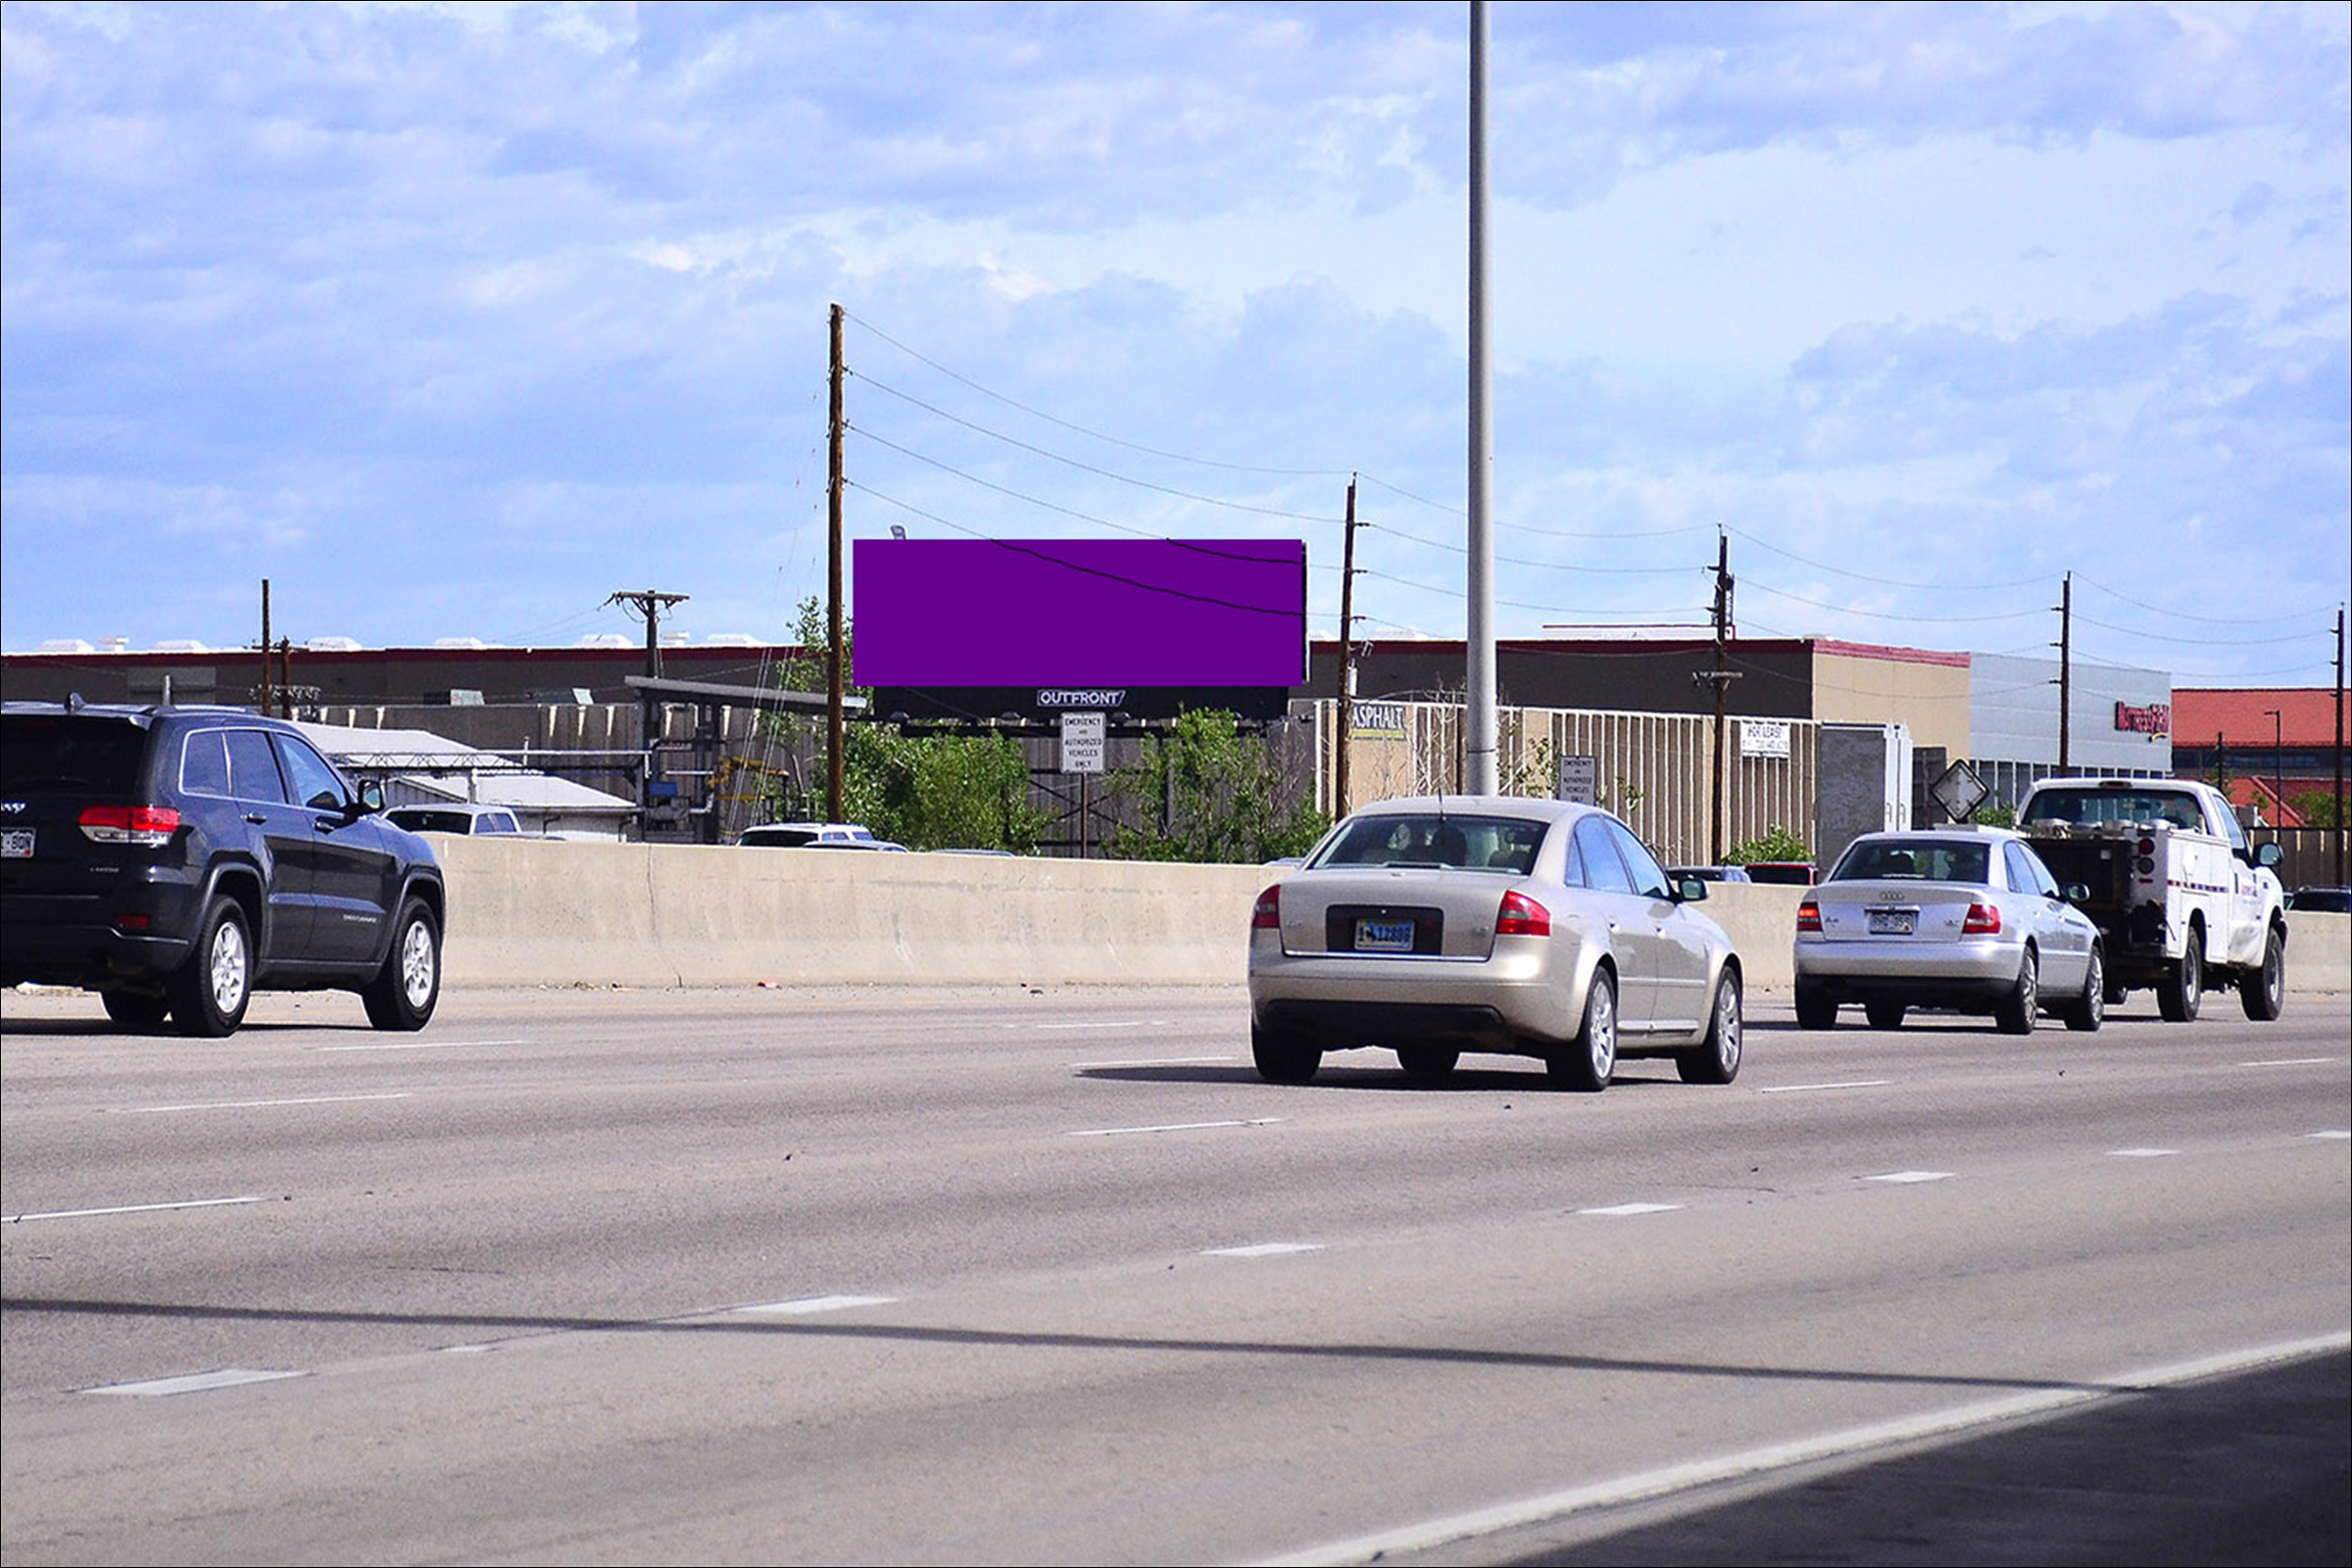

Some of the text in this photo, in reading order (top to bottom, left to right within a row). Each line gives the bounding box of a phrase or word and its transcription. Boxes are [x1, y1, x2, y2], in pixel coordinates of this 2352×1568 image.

[1041, 691, 1119, 705] OUTFRONT
[1064, 717, 1102, 726] EMERGENCY
[1352, 706, 1404, 729] ASPHALT
